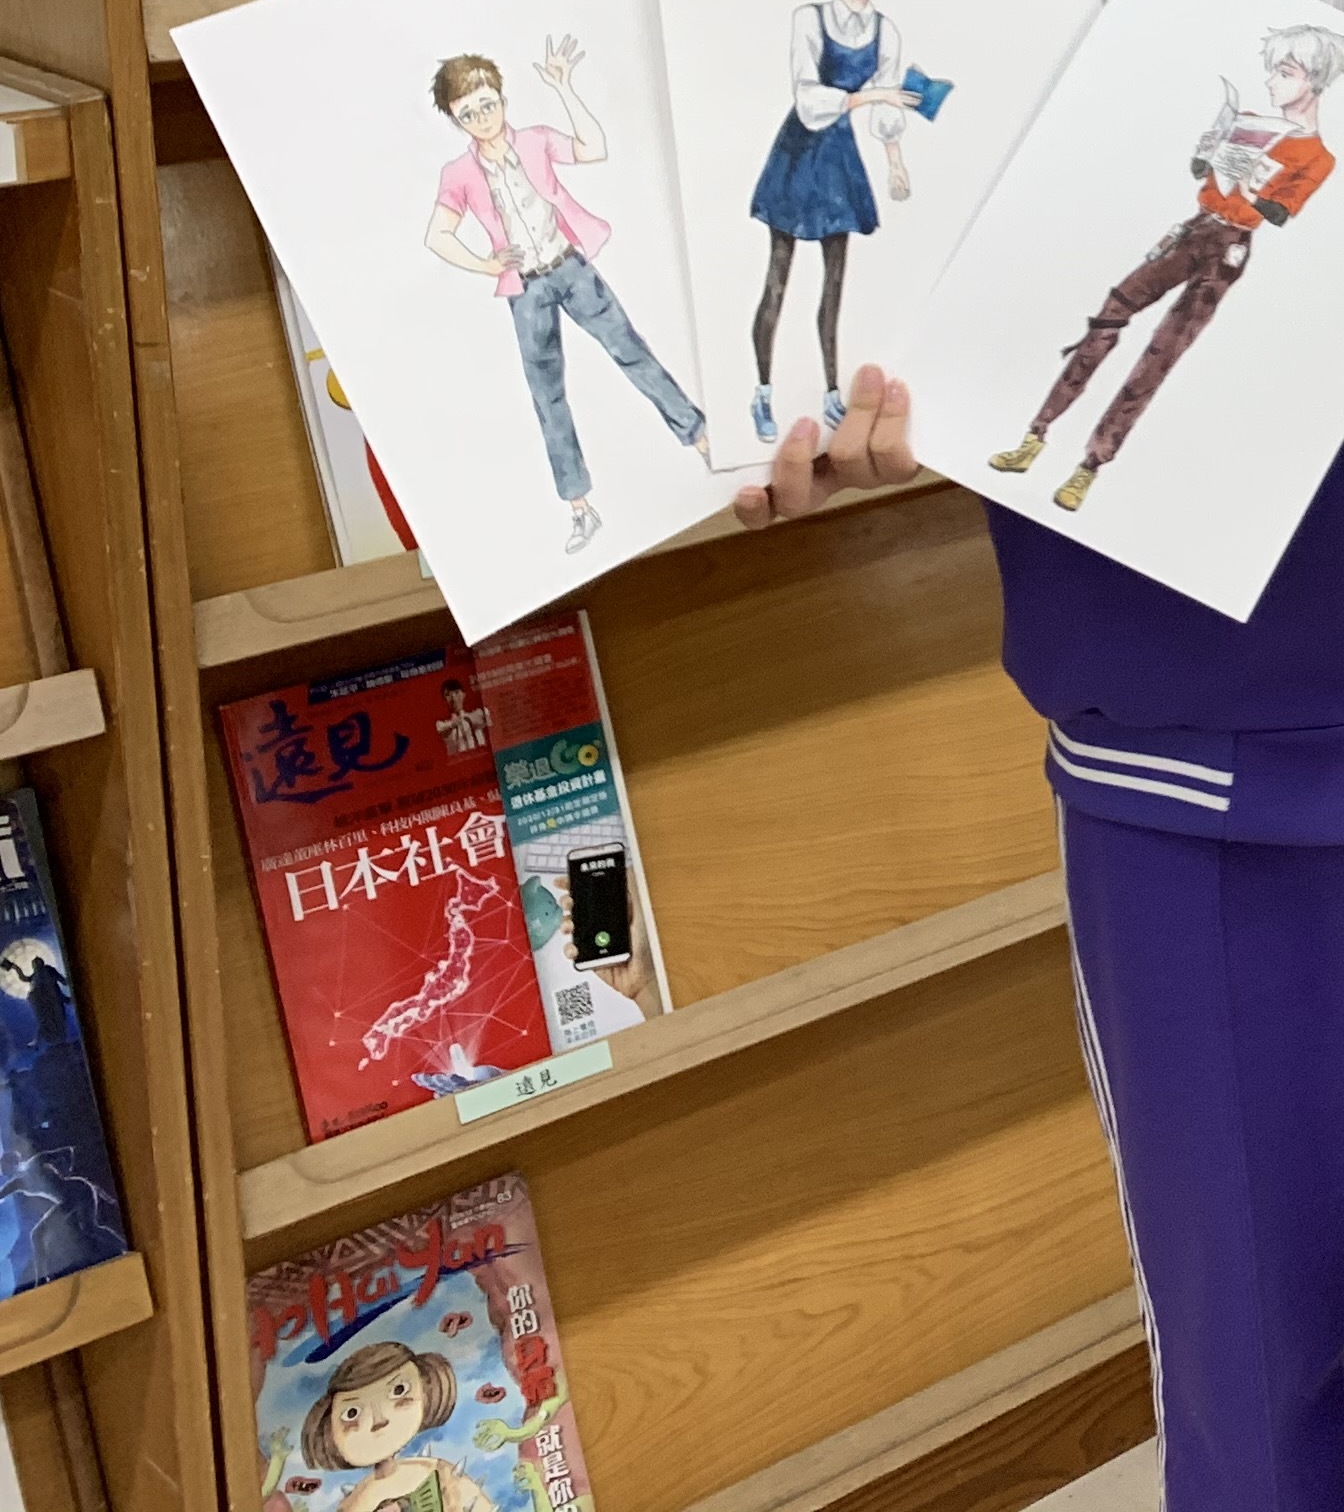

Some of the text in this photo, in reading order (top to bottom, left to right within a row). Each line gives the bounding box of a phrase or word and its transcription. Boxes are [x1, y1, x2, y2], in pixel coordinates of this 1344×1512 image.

[243, 697, 409, 804] 遠見
[284, 811, 507, 921] 日本社會
[516, 1067, 558, 1098] 遠見
